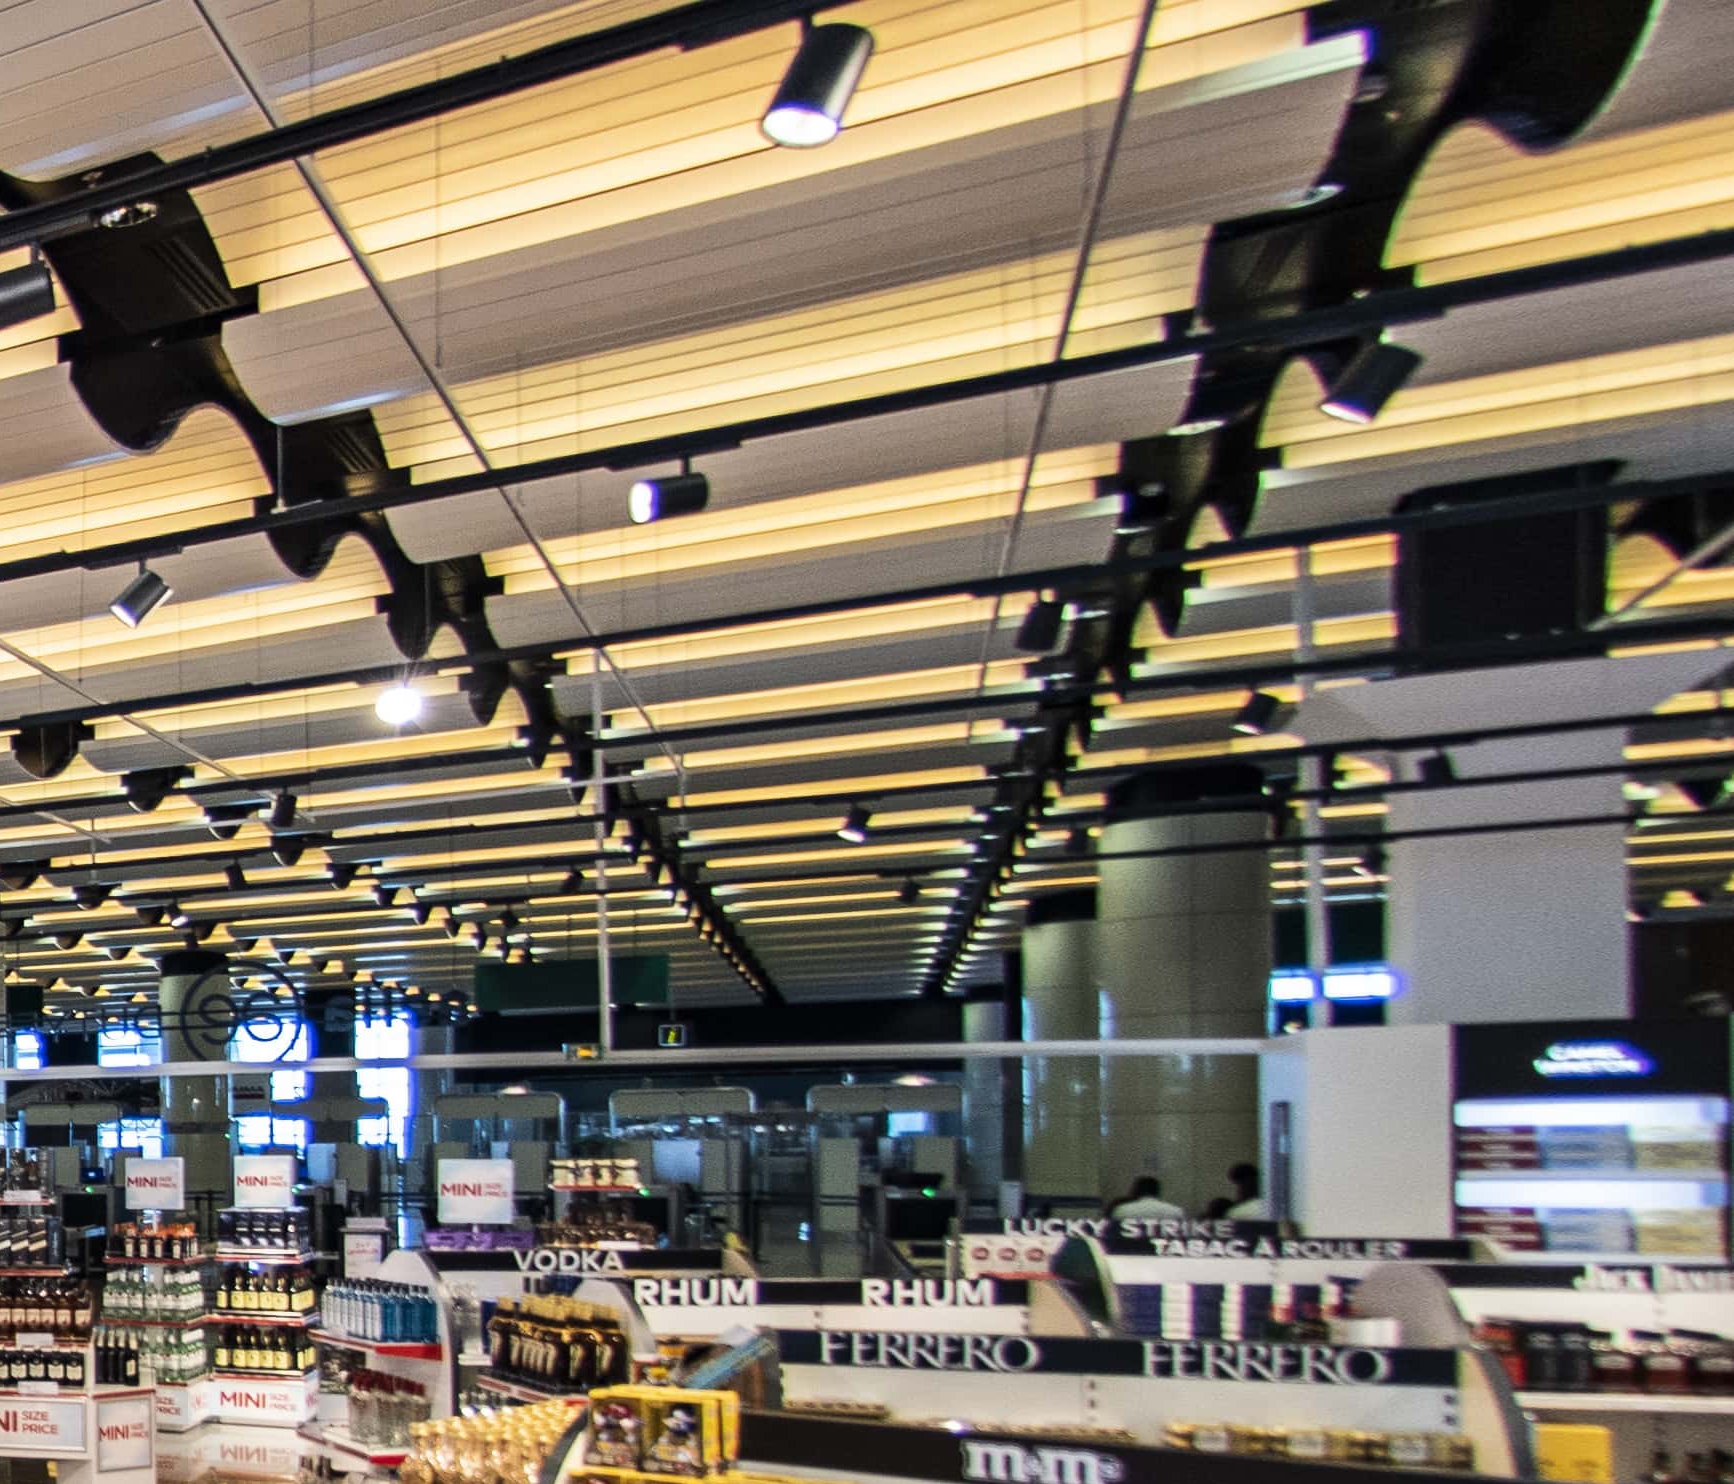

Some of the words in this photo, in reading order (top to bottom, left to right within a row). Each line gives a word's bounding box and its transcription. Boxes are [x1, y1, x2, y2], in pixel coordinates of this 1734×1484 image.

[127, 1176, 158, 1188] MINI
[237, 1176, 267, 1187] MINI
[441, 1183, 481, 1197] MINI
[1004, 1217, 1110, 1239] LUCKY
[1120, 1218, 1234, 1240] STRIKE
[1154, 1238, 1247, 1259] TABAC
[1284, 1240, 1407, 1261] ROULER
[513, 1249, 625, 1272] VODKA
[633, 1278, 758, 1306] RHUM
[862, 1278, 994, 1307] RHUM
[819, 1330, 1040, 1373] FERRERO
[1143, 1340, 1392, 1384] FERRERO
[219, 1391, 266, 1409] MINI
[21, 1411, 50, 1422] SIZE
[21, 1424, 59, 1435] PRICE
[99, 1425, 130, 1441] MINI
